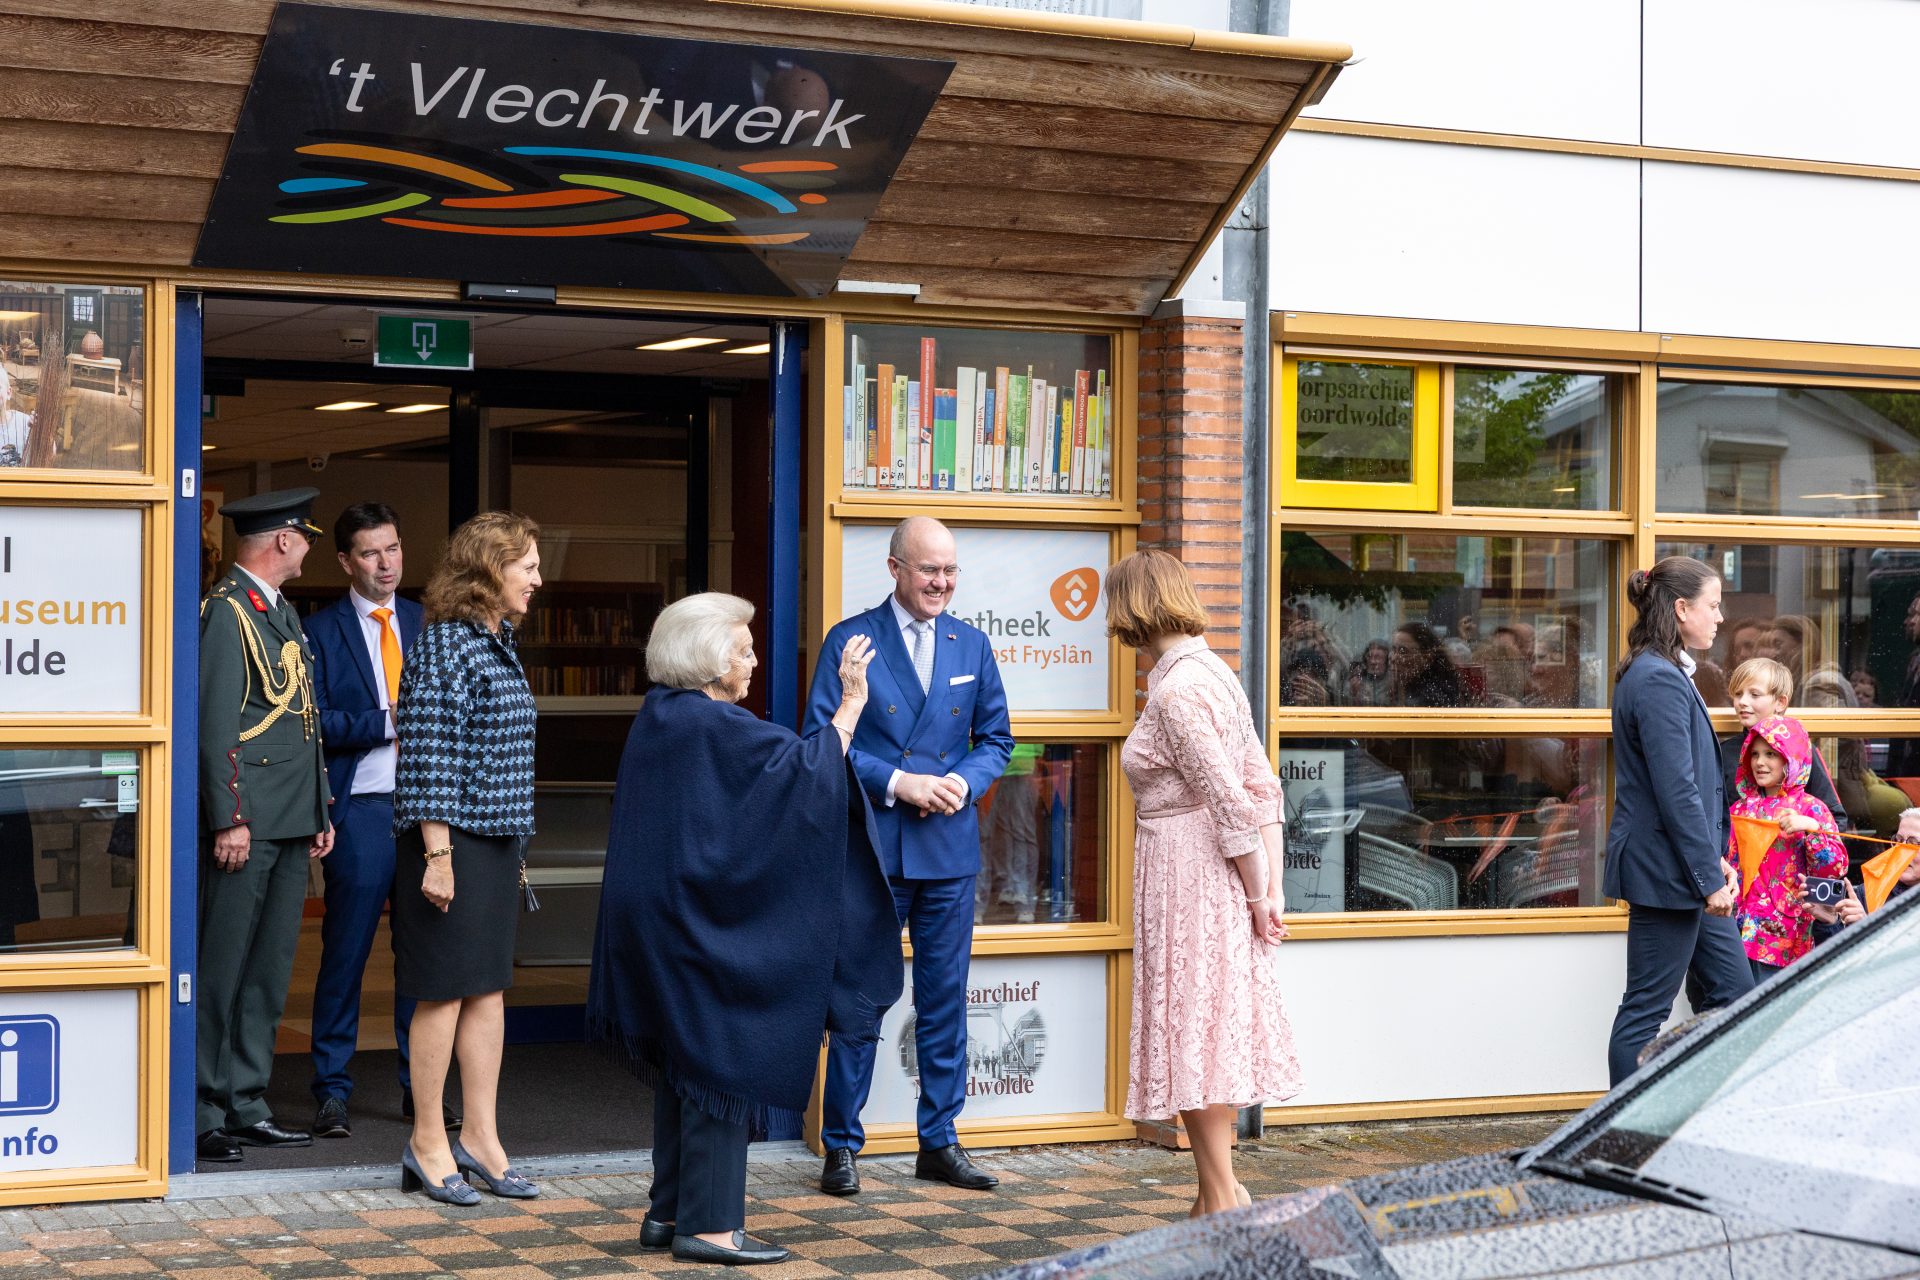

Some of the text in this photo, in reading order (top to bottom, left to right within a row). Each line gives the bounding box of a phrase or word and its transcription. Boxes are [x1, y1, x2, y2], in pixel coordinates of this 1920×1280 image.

[409, 62, 867, 149] Vlechtwerk
[1298, 378, 1410, 403] orpsarchie
[1297, 403, 1408, 427] oordwolde
[0, 639, 66, 676] lde
[1023, 644, 1092, 670] Fryslân
[1280, 760, 1327, 781] chief
[1283, 849, 1322, 870] olde
[3, 1126, 58, 1157] nfo
